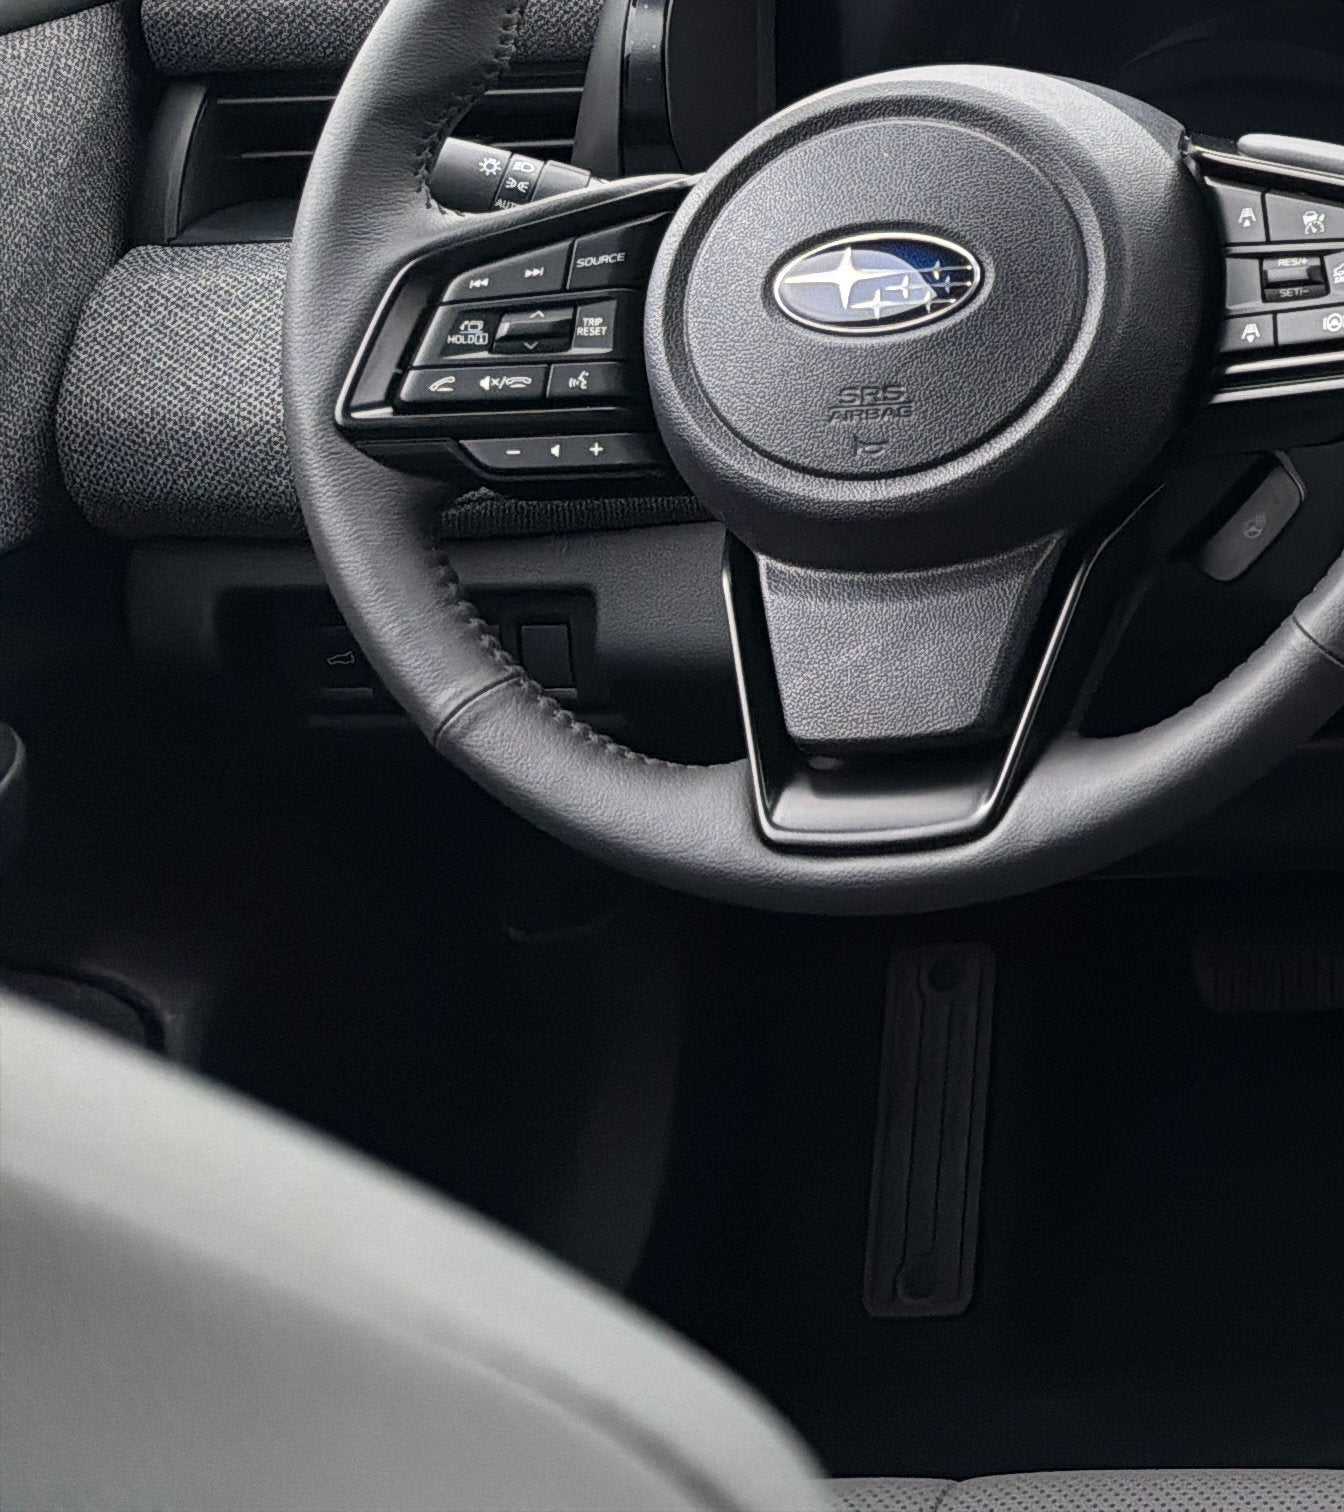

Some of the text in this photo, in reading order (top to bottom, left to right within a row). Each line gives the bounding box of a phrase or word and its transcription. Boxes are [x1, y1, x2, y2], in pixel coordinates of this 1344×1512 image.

[576, 252, 626, 268] SOURCE
[582, 317, 604, 327] TRIP
[446, 332, 475, 345] HOLD
[576, 326, 608, 337] RESET
[839, 384, 906, 404] SRS
[827, 406, 913, 423] AIRBAG
